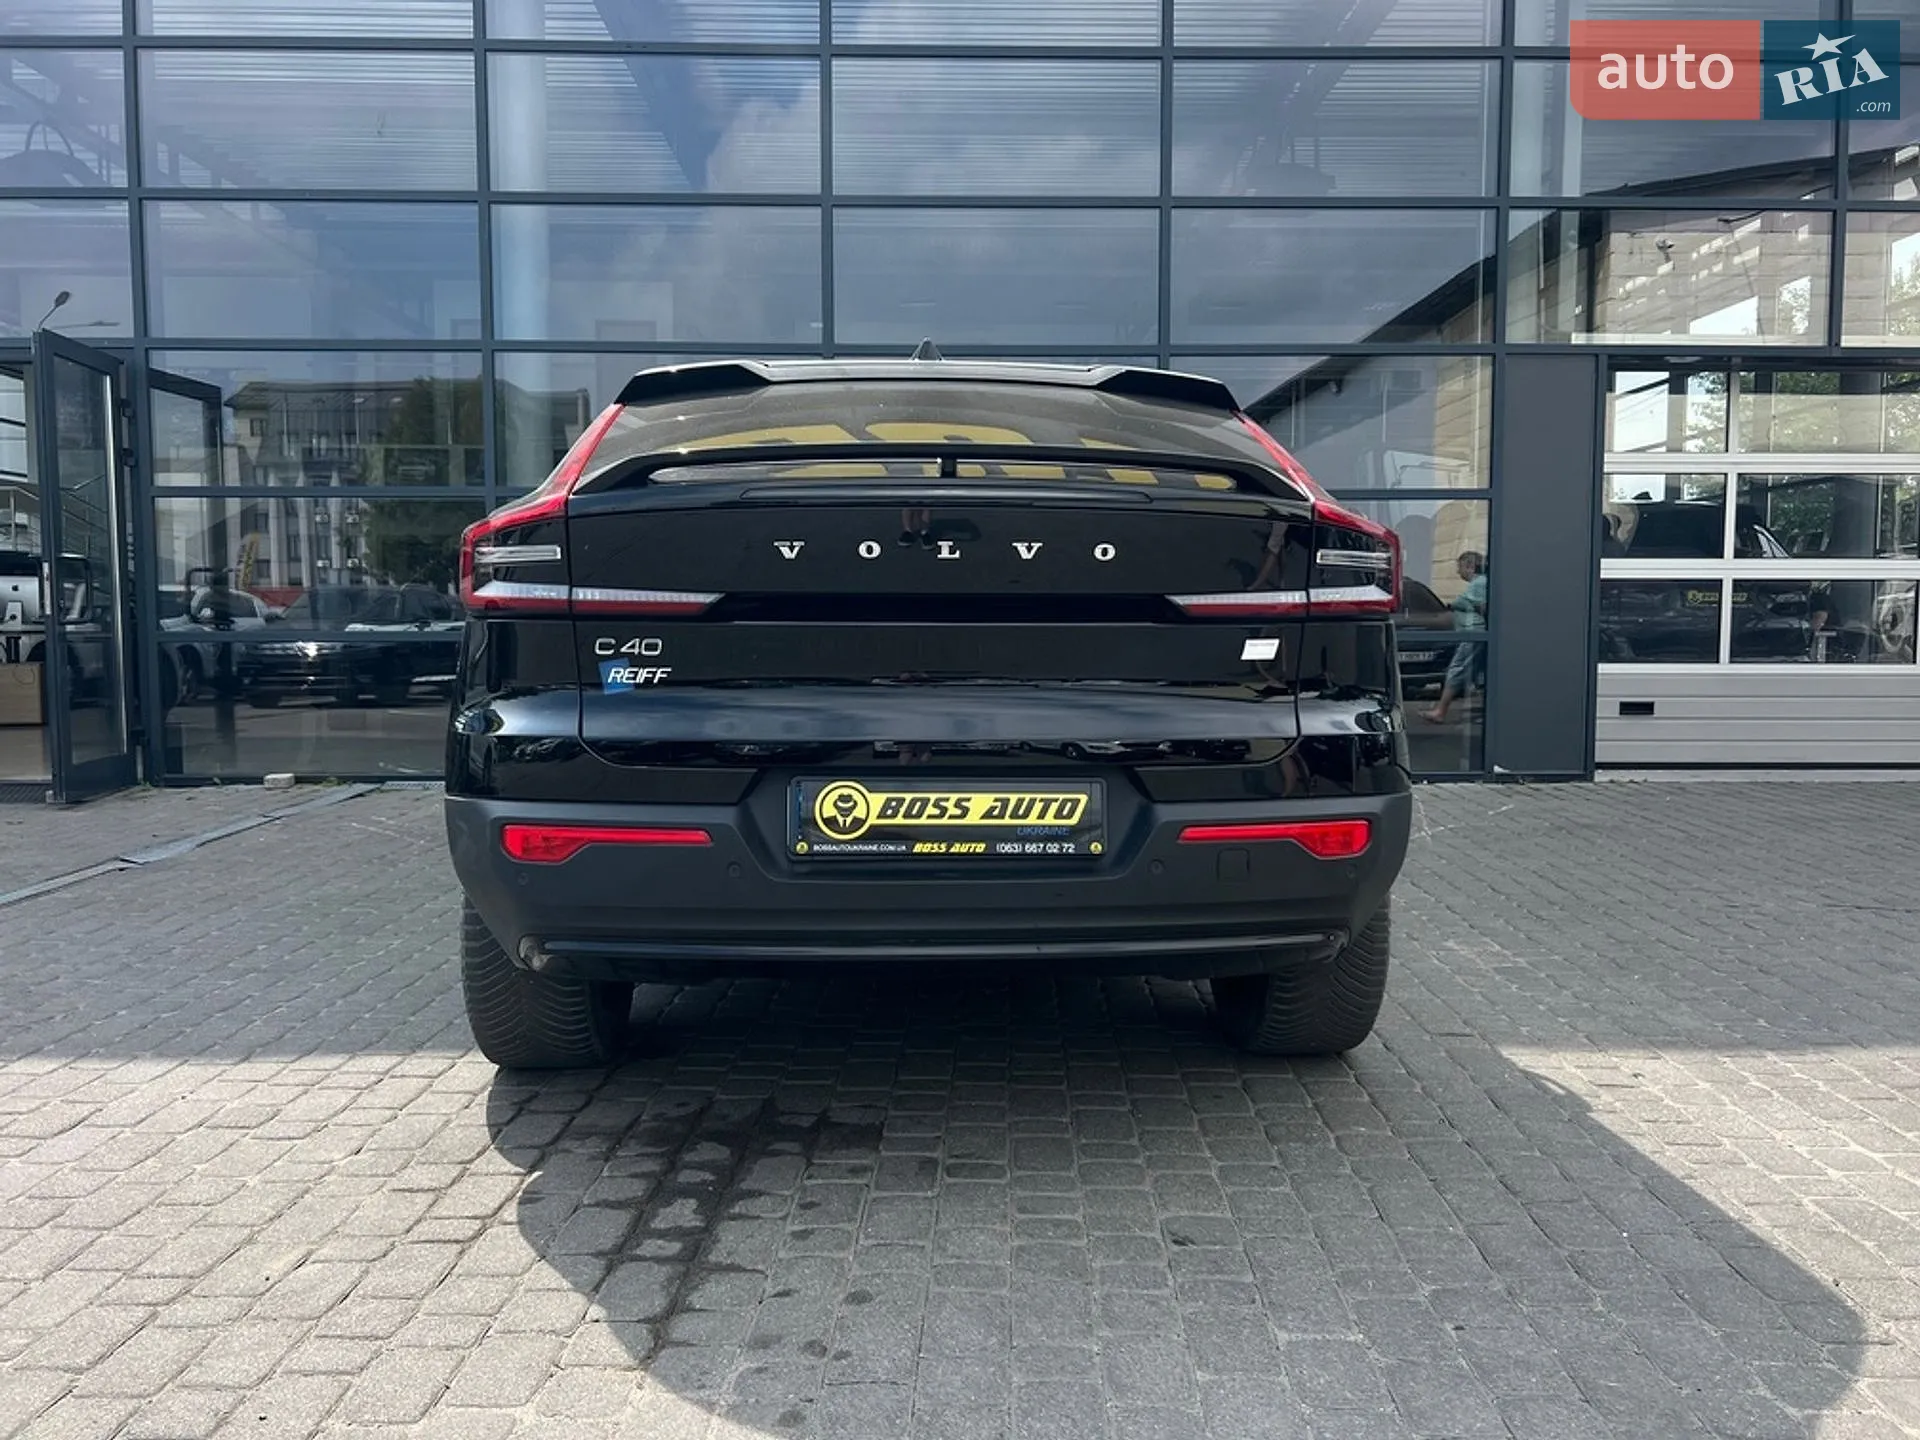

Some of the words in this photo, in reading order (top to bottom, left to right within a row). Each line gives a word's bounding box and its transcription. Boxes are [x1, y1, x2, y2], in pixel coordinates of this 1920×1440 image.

[773, 540, 1116, 562] VOLVO
[607, 667, 672, 683] REIFF
[876, 797, 972, 820] BOSS
[980, 797, 1081, 820] AUTO
[1016, 826, 1071, 836] UKRAINE
[912, 842, 947, 853] BOSS
[949, 842, 986, 853] AUTO
[996, 843, 1022, 853] (063)
[1062, 843, 1076, 853] 72
